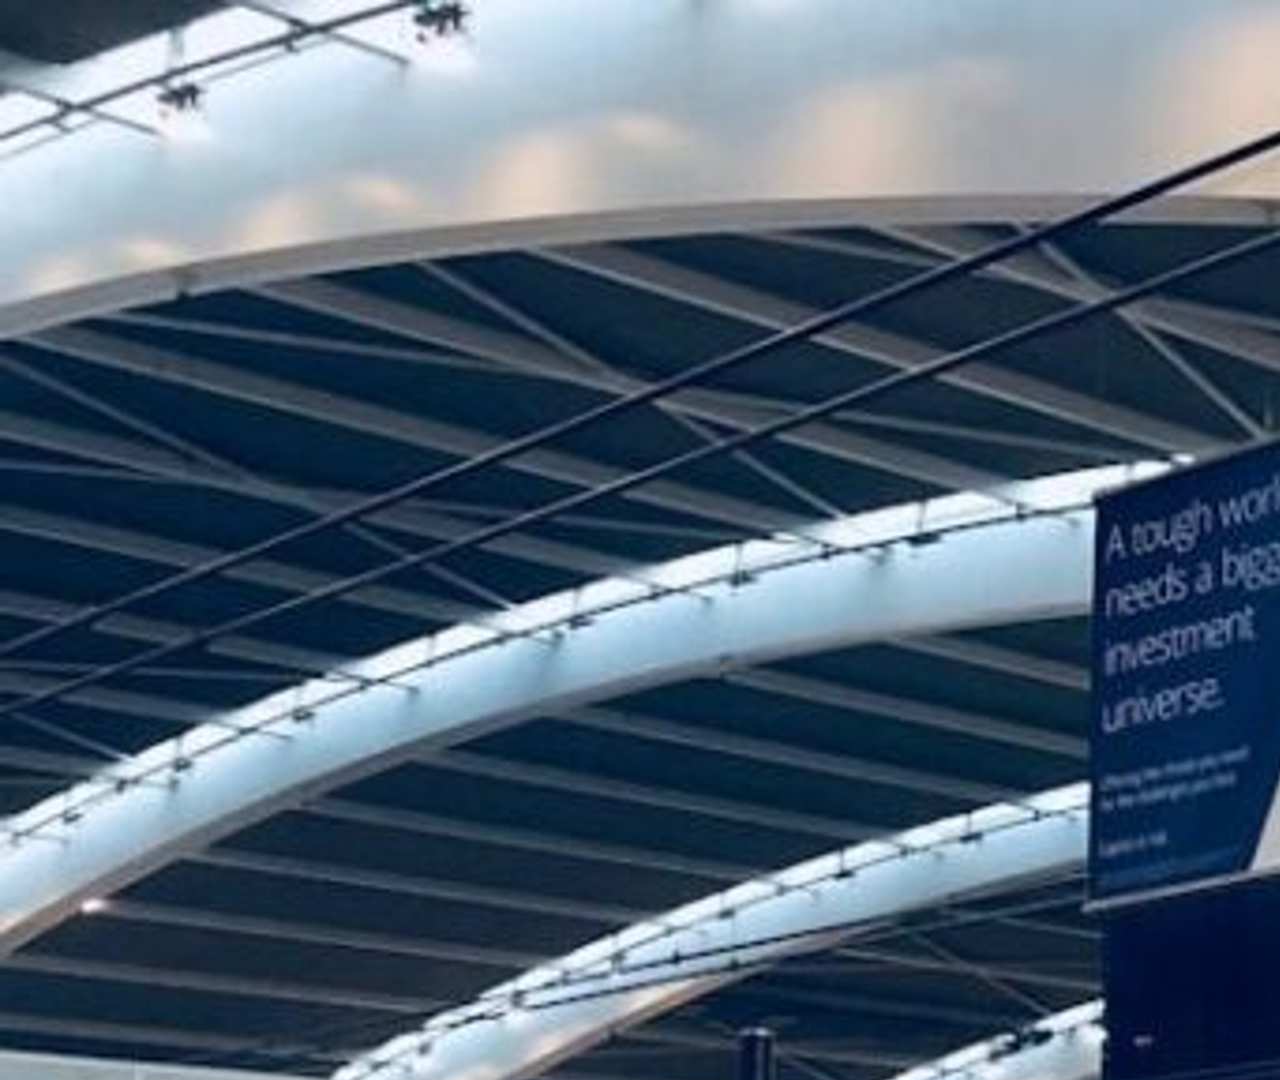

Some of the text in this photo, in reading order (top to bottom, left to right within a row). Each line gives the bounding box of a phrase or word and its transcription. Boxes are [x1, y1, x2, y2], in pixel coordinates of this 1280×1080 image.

[1106, 522, 1126, 563] A
[1131, 500, 1213, 556] tough
[1105, 561, 1189, 618] needs
[1194, 559, 1213, 595] a
[1103, 602, 1256, 677] investment
